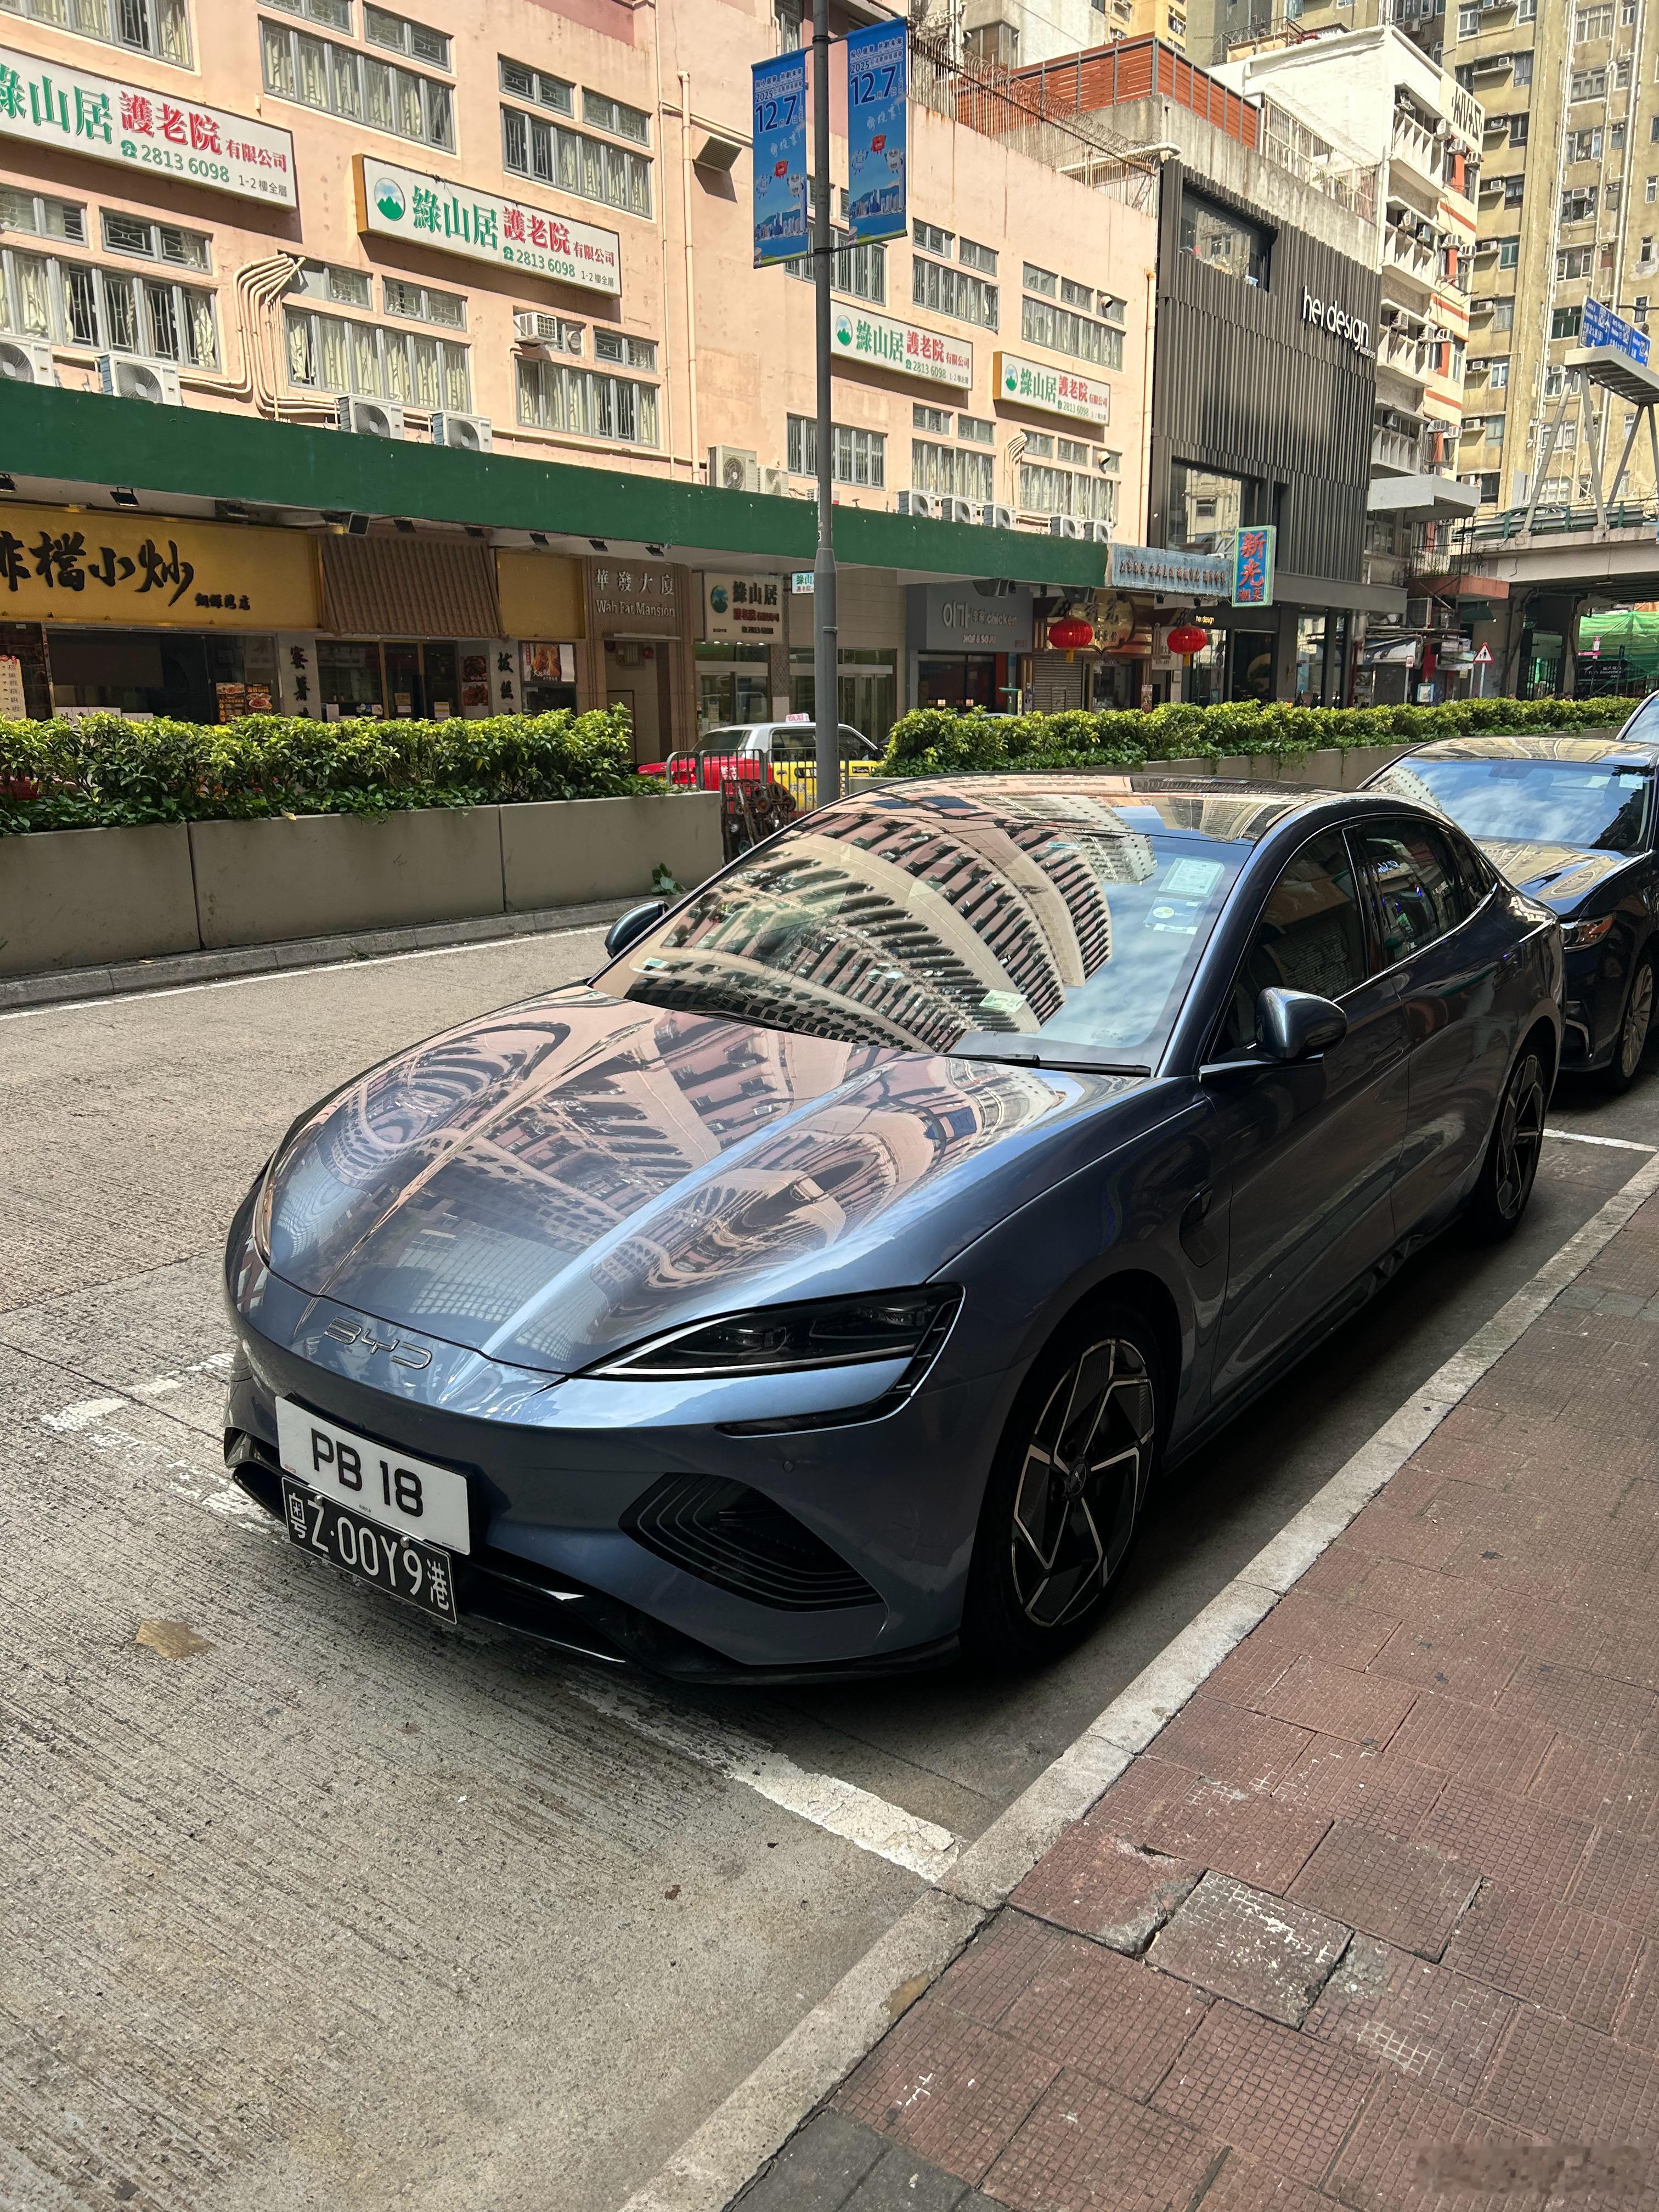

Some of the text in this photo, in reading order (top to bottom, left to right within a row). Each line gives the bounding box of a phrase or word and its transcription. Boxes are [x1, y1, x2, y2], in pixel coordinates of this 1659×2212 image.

[851, 60, 869, 74] 2025
[755, 90, 773, 102] 2025
[0, 63, 286, 172] 綠山居 護老院 有限公司
[142, 145, 229, 182] 2813 6098
[239, 174, 256, 189] 1-2
[412, 185, 614, 267] 綠山居 護老院 有限公司
[517, 249, 575, 277] 2813 6098
[1327, 301, 1368, 351] design
[856, 319, 904, 363] 綠山居
[907, 330, 944, 363] 護老院
[913, 361, 946, 379] 2813 6098
[1238, 532, 1267, 586] 新光
[596, 569, 675, 595] 華發大廈
[796, 574, 814, 585] 綠山
[596, 599, 675, 617] Wah Fat Mansion
[987, 612, 1018, 626] chicken
[325, 1317, 432, 1369] BYD
[311, 1427, 424, 1517] PB 18
